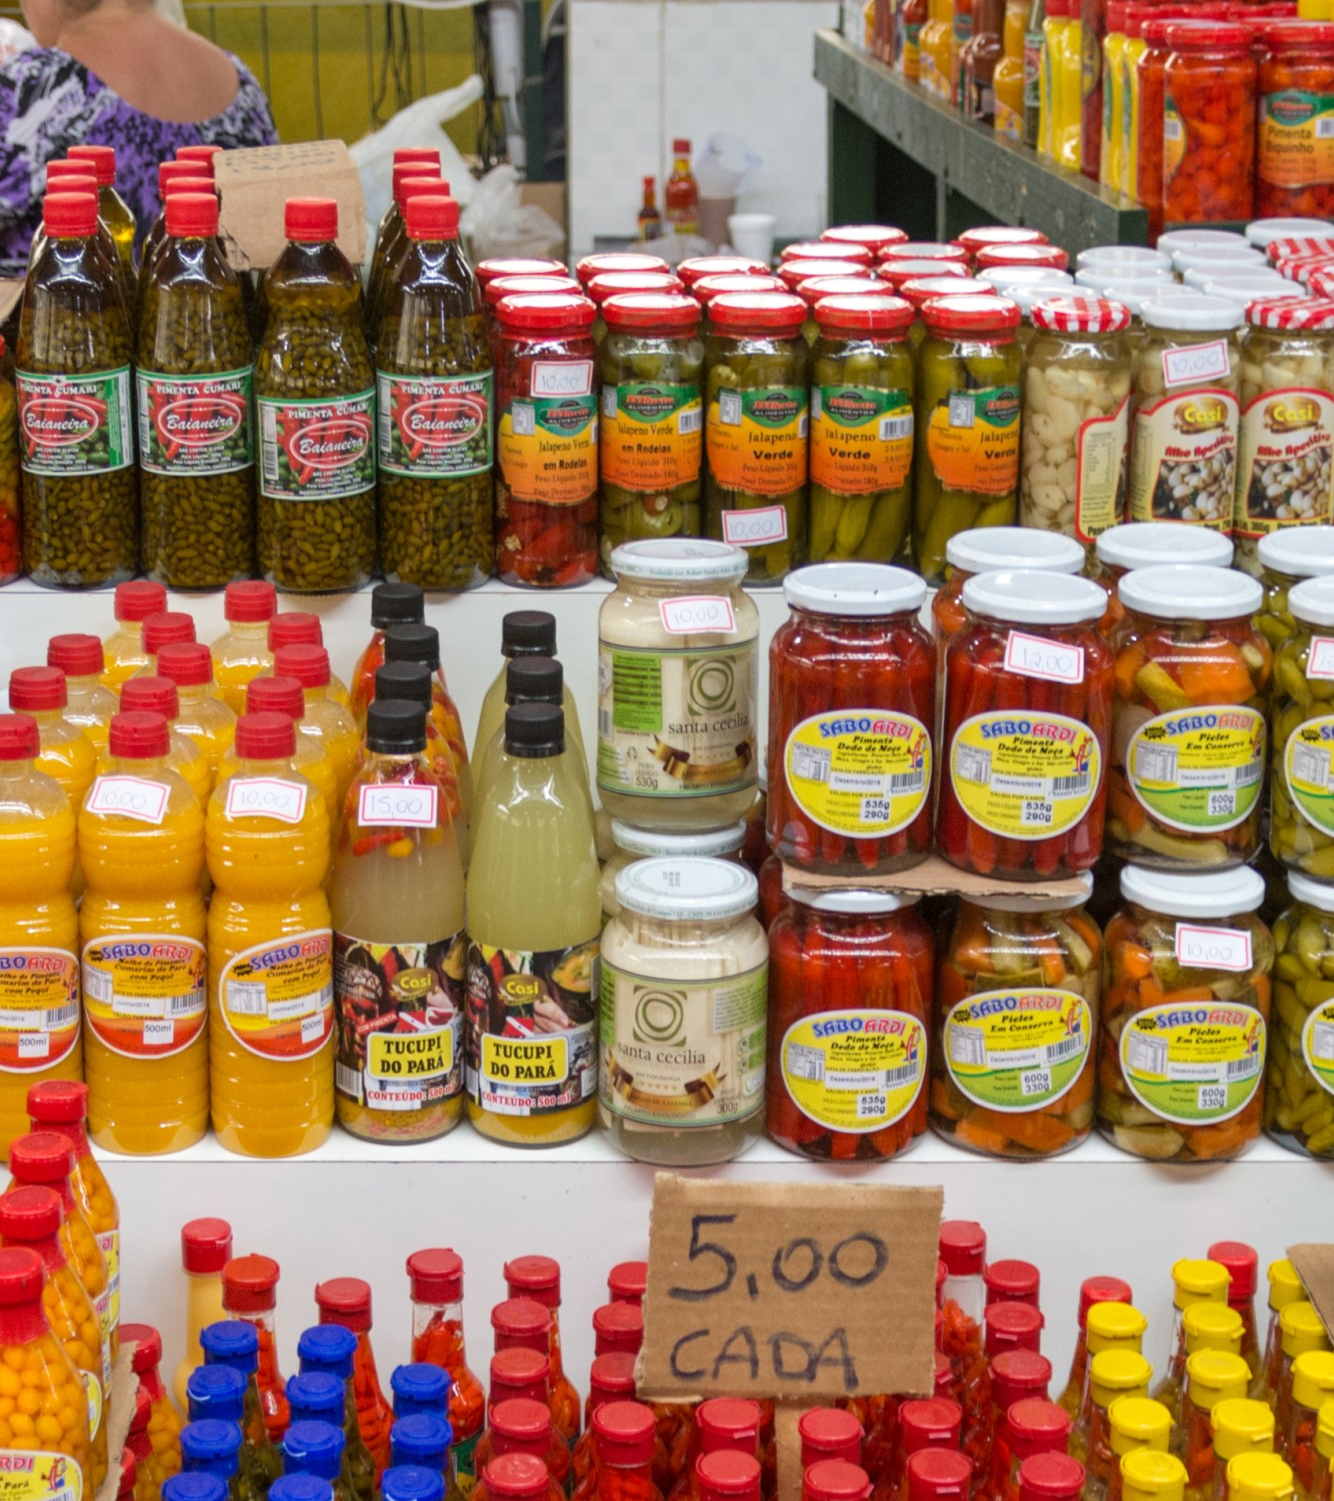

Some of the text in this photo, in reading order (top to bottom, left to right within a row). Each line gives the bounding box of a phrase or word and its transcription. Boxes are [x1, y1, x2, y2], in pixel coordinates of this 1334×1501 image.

[157, 382, 241, 396] PIMENTA CUMARI
[402, 385, 441, 395] PIMENTA
[288, 409, 332, 420] PIMENTA
[1183, 405, 1222, 424] Casi
[1273, 404, 1314, 422] Casi
[753, 449, 793, 461] Verde
[829, 447, 871, 460] Verde
[668, 713, 750, 734] santa cecilia
[819, 718, 914, 741] SABOARDI
[635, 777, 659, 791] 530g
[864, 800, 891, 812] 535g
[863, 811, 891, 823] 290g
[399, 973, 432, 990] Casi
[506, 980, 539, 996] Casi
[968, 994, 1065, 1020] SABOARDI
[144, 1023, 172, 1035] 500ml
[19, 1037, 47, 1048] 500ml
[383, 1036, 442, 1054] TUCUPI
[492, 1042, 553, 1060] TUCUPI
[617, 1042, 707, 1066] santa cecilia
[380, 1051, 445, 1074] DO PARÁ
[490, 1060, 557, 1079] DO PARÁ
[1024, 1073, 1051, 1084] 600g
[1023, 1083, 1051, 1095] 330g
[668, 1326, 859, 1392] CADA
